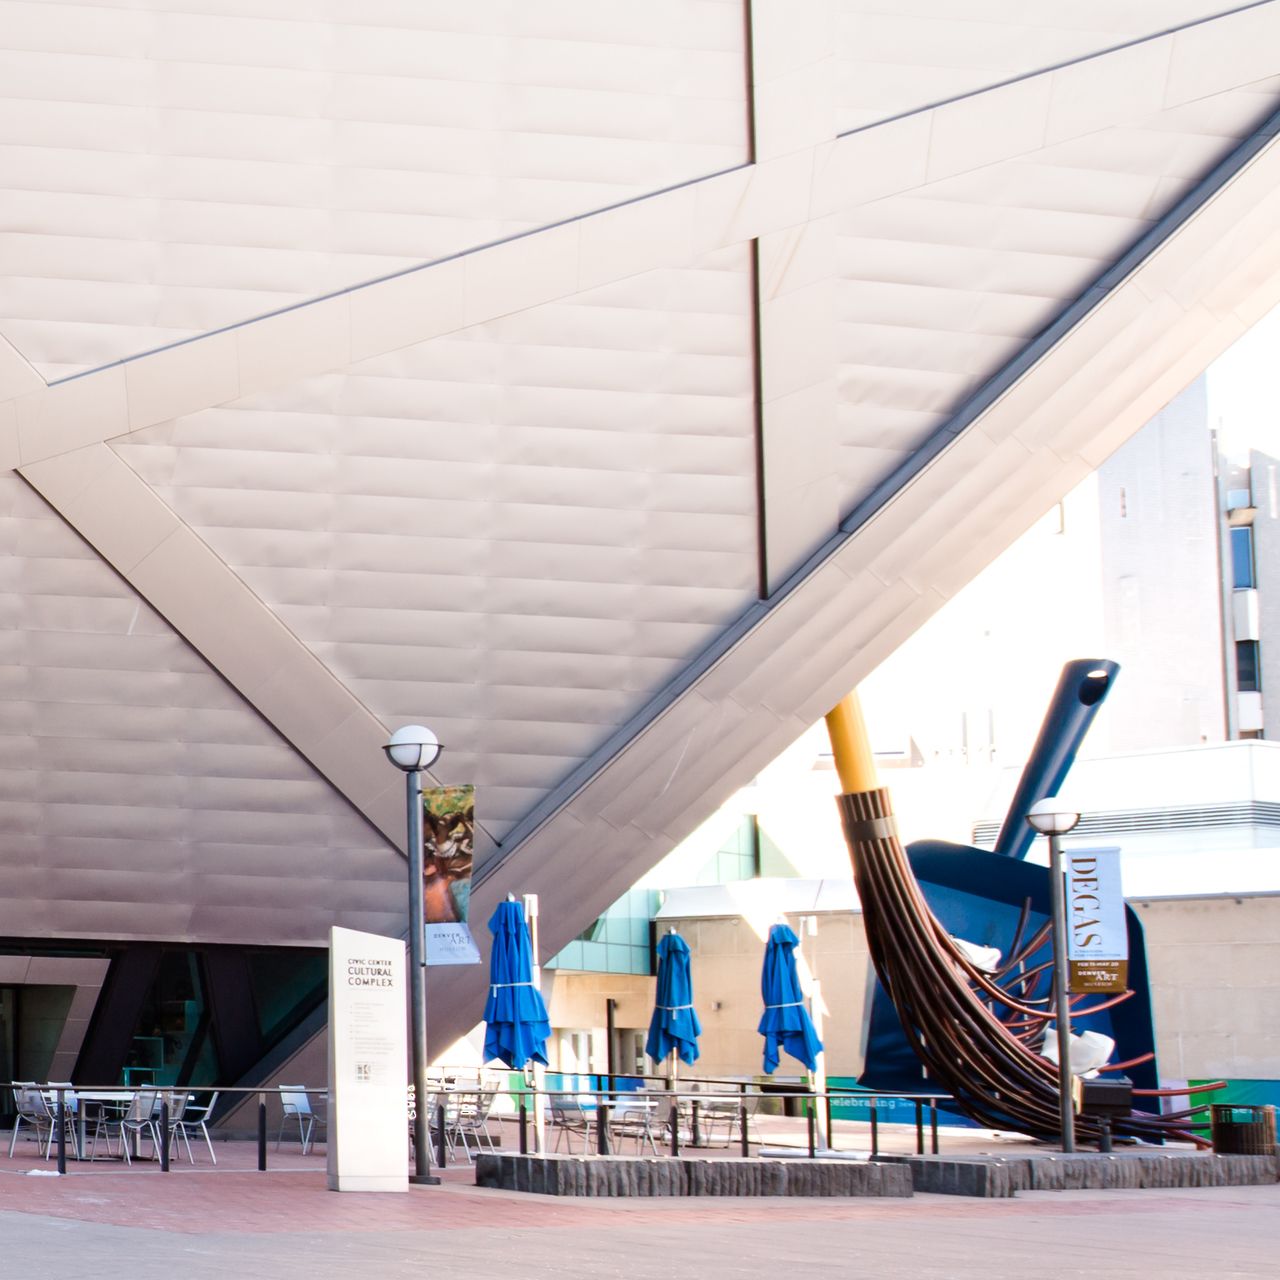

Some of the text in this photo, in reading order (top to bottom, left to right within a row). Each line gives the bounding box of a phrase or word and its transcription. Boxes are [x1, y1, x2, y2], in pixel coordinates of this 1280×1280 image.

[1071, 858, 1102, 948] DEGAS
[347, 958, 392, 967] CIVIC CENTER
[347, 967, 393, 977] CULTURAL
[1095, 973, 1119, 981] ART
[347, 977, 393, 987] COMPLEX
[829, 1098, 896, 1109] elebraing
